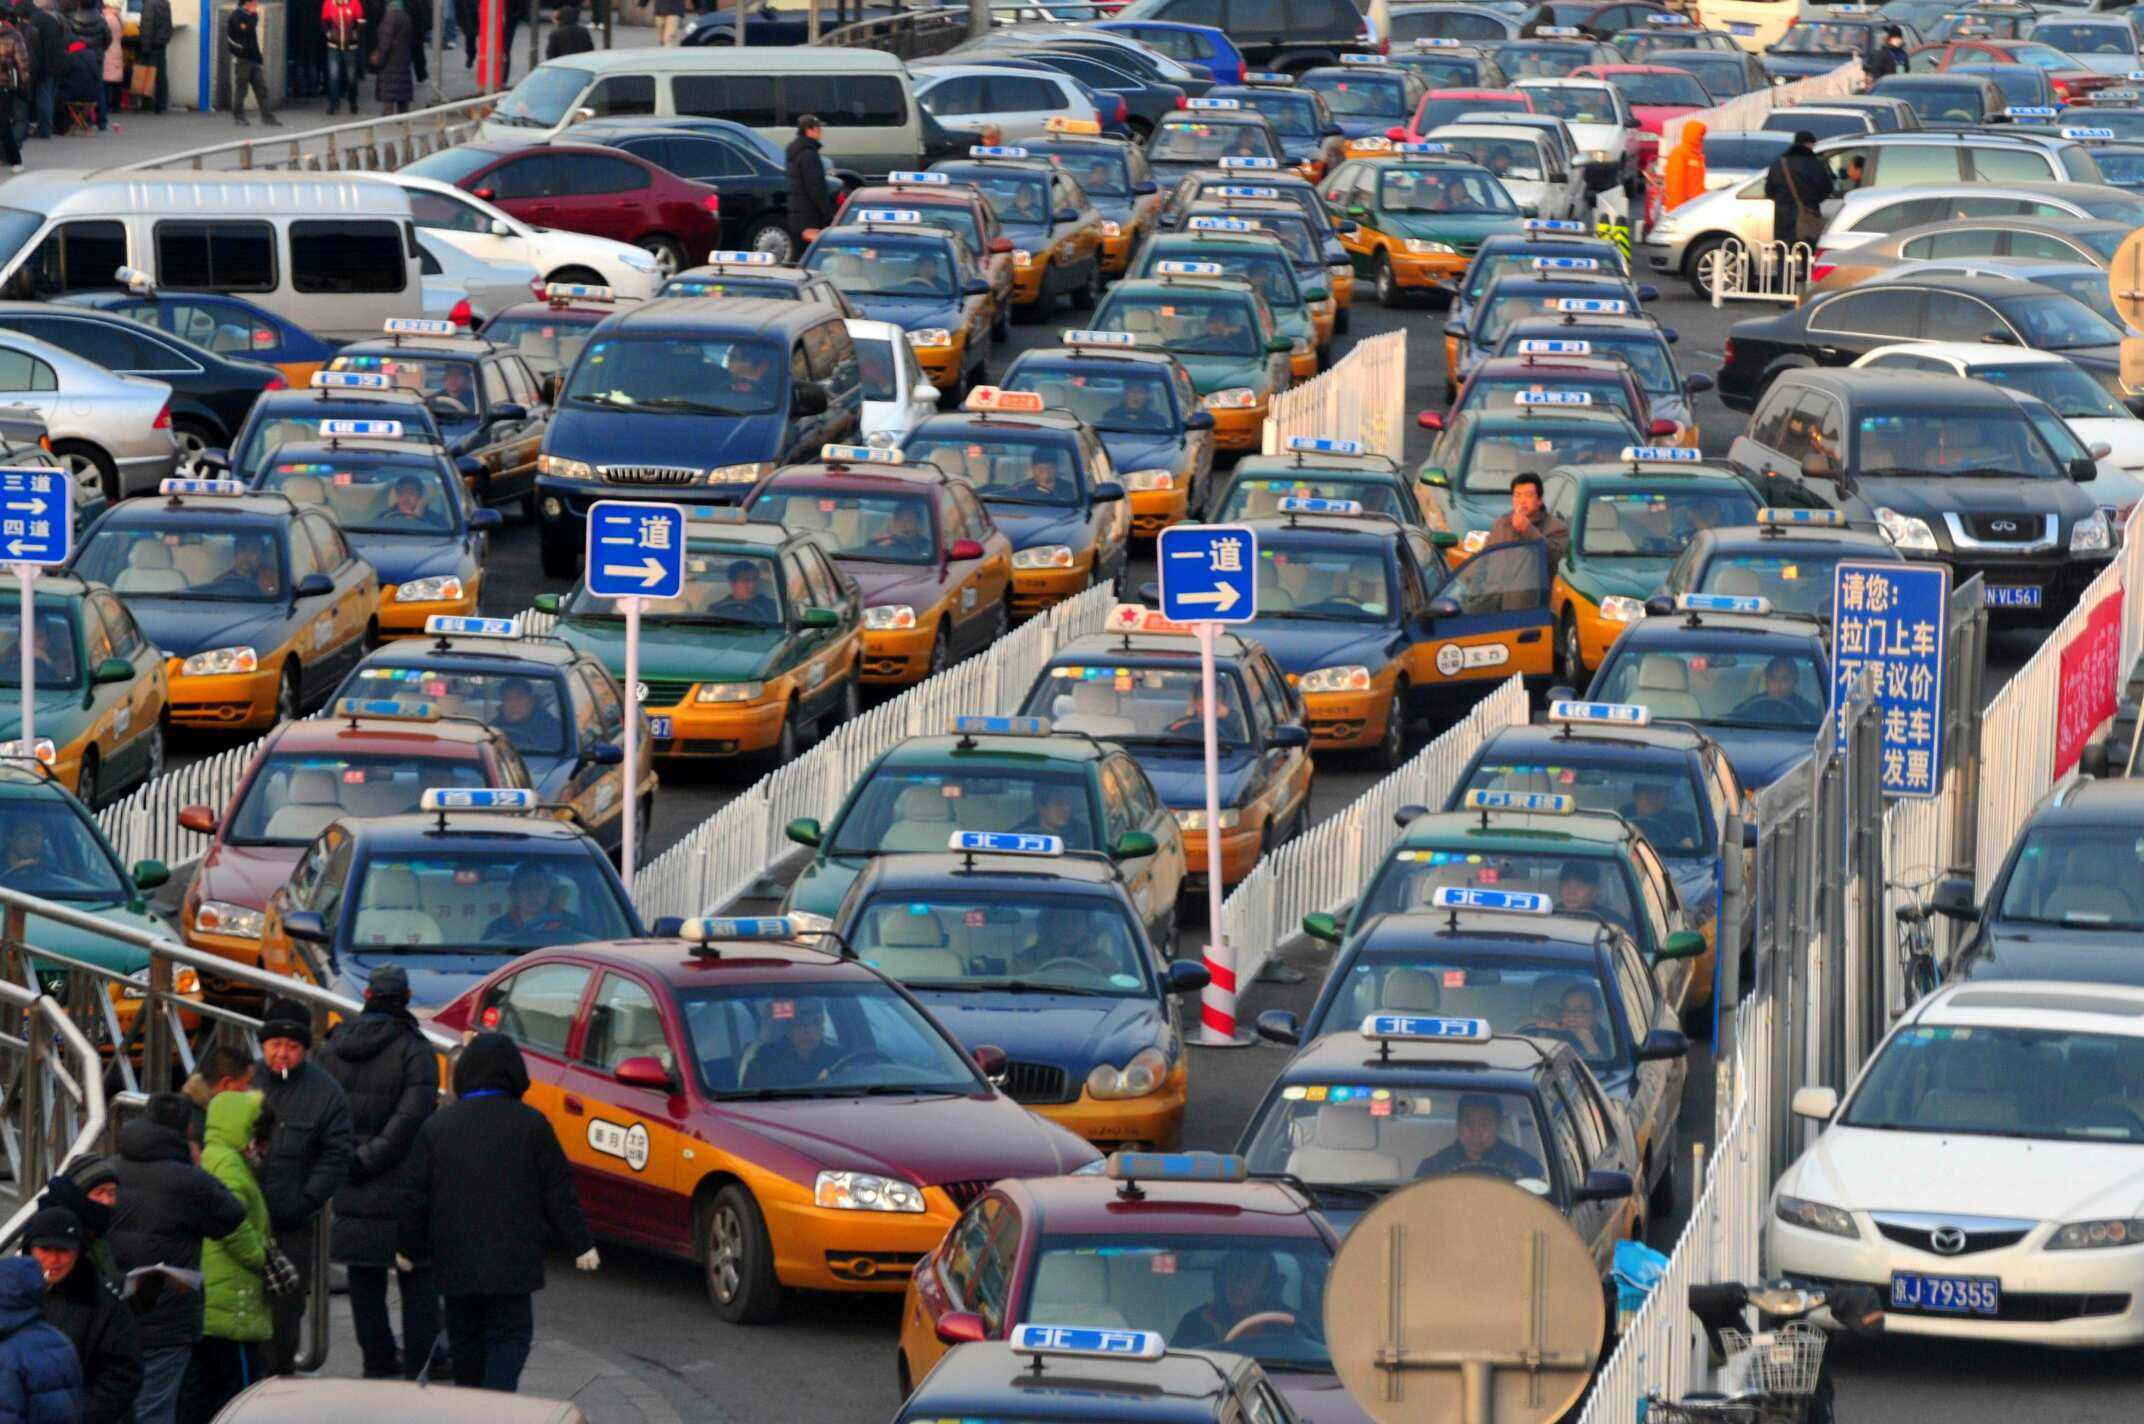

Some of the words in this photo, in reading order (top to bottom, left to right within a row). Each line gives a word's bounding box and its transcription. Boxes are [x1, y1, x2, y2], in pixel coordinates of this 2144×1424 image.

[3, 474, 51, 492] 三道
[3, 519, 50, 537] 四道
[601, 515, 671, 549] 二道
[1171, 537, 1242, 571] 一道
[1840, 616, 1935, 659] 拉门上车
[969, 832, 1047, 852] 北方
[1453, 890, 1532, 908] 北方
[1384, 1018, 1470, 1037] 北方
[1034, 1327, 1136, 1351] 北方
